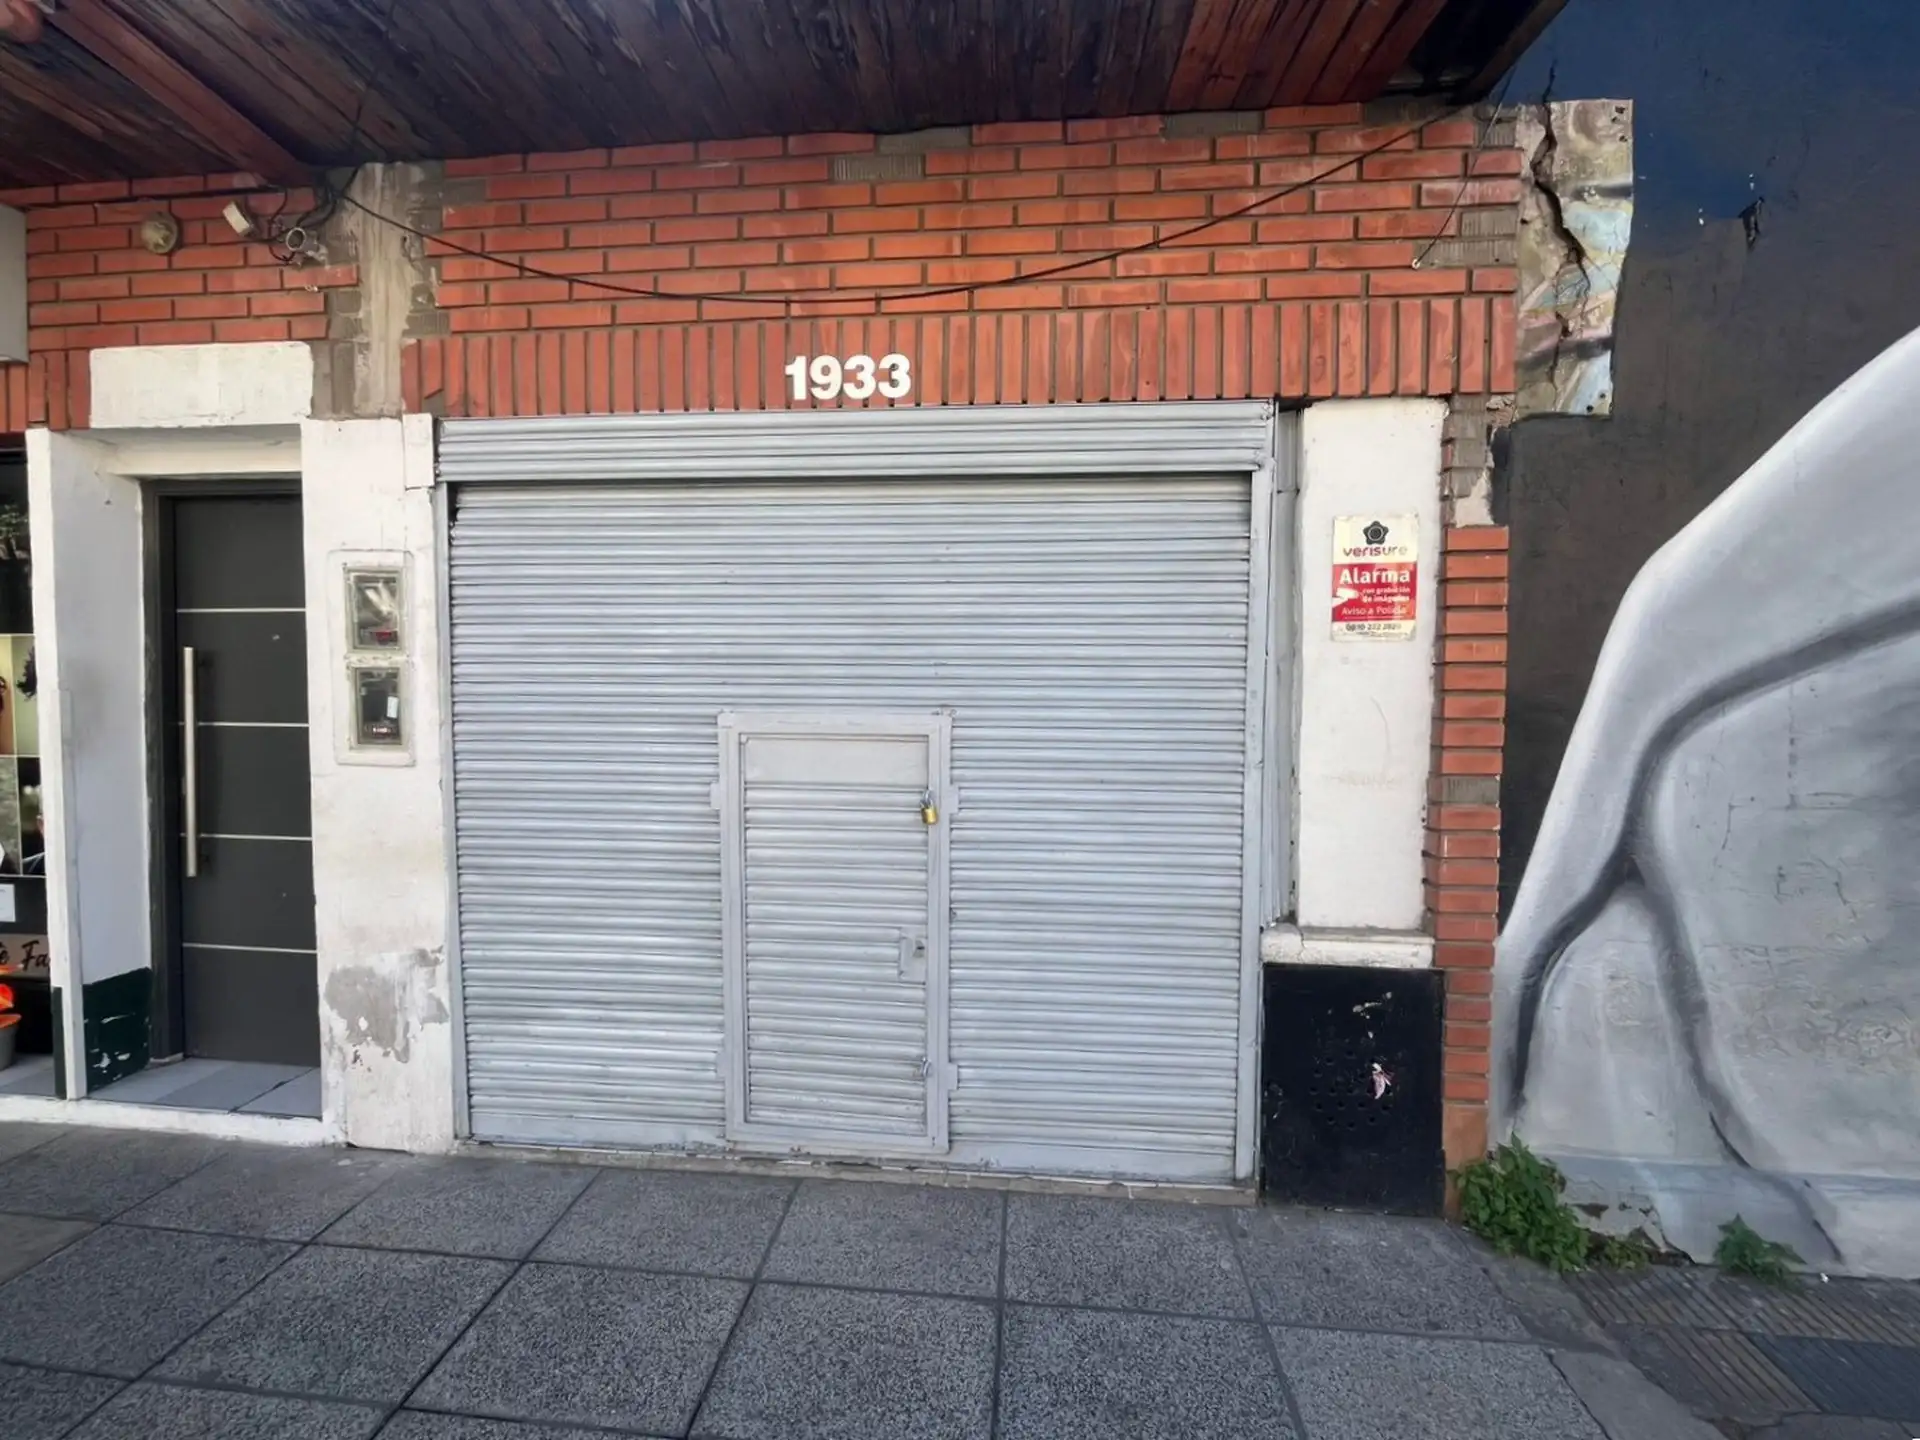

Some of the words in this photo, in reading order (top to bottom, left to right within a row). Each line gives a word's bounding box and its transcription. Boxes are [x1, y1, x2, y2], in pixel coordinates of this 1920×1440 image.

[785, 353, 911, 400] 1933
[1343, 546, 1408, 557] verisure
[1340, 567, 1410, 584] Alarma
[1342, 606, 1366, 615] Aviso
